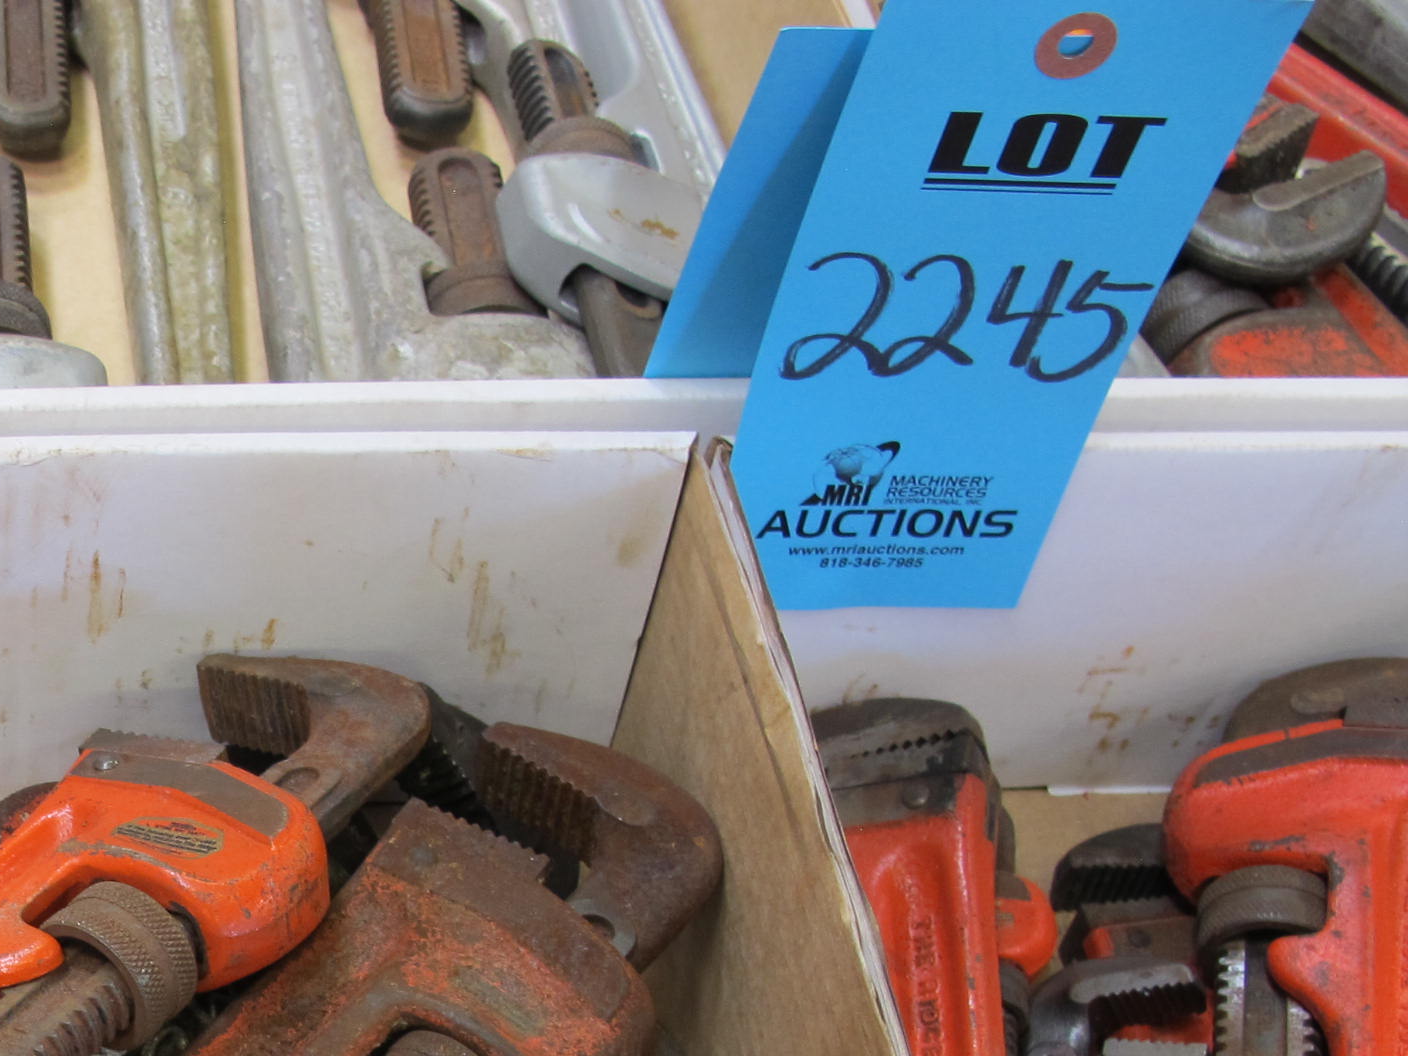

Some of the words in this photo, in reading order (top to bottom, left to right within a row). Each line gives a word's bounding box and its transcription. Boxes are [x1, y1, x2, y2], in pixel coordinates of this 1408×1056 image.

[928, 111, 1168, 178] LOT
[779, 252, 1154, 383] 2245
[890, 475, 994, 488] MACHINERY
[886, 487, 988, 498] RESOURCES
[755, 509, 1018, 539] AUCTIONS
[788, 543, 965, 556] www.mriauctions.com
[819, 557, 924, 568] 818-346-7985
